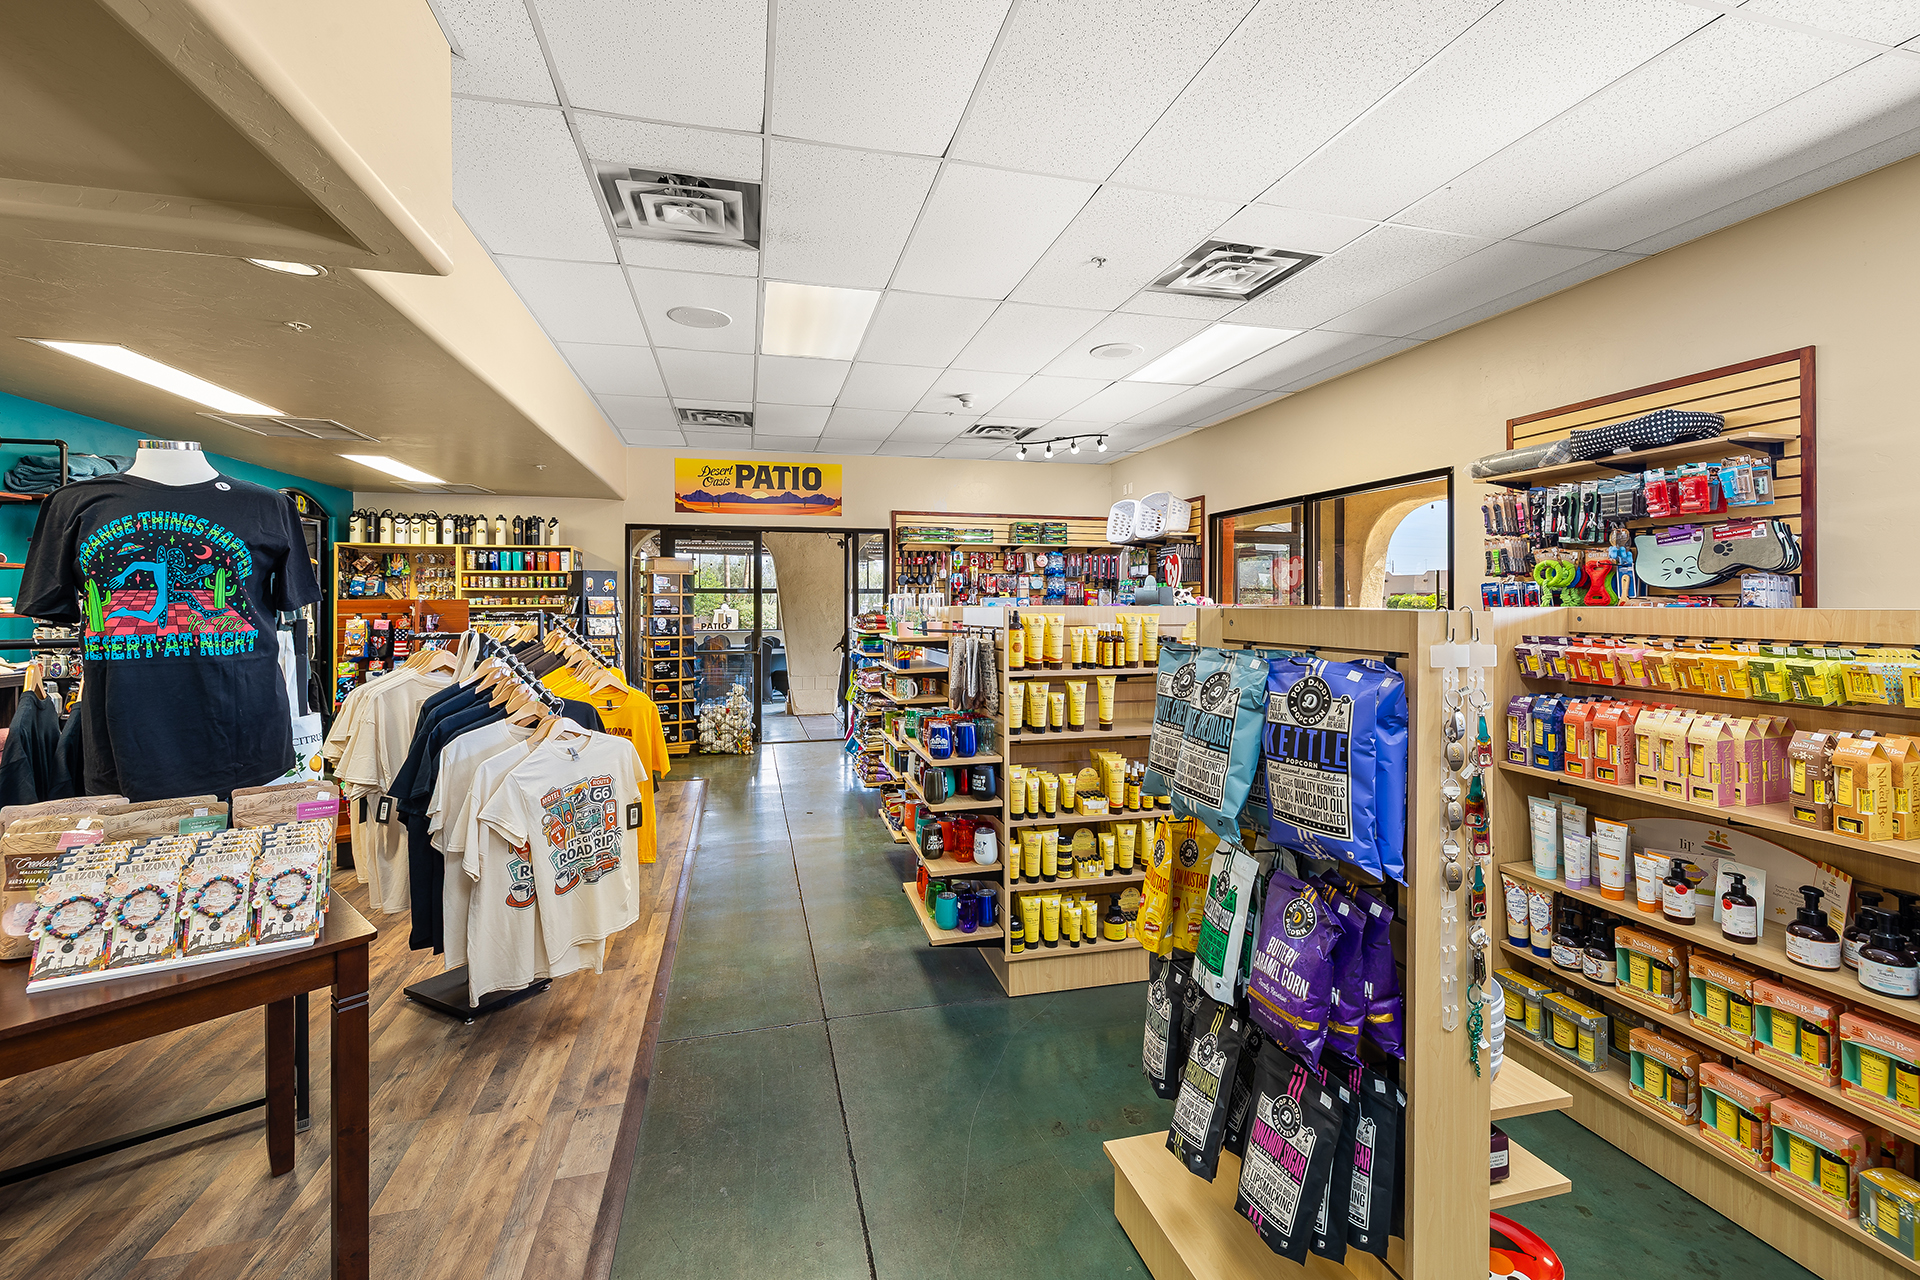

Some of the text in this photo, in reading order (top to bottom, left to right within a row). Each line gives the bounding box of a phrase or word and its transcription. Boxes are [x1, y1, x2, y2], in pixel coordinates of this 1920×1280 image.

[698, 464, 822, 490] Desert PATIO
[702, 476, 730, 487] Oasis
[137, 511, 209, 536] THINGS
[205, 523, 253, 580] HAPPEN
[1166, 557, 1178, 588] ty
[187, 614, 245, 632] In The
[701, 622, 729, 630] PATIO
[164, 632, 192, 658] AT
[200, 629, 259, 656] NIGHT
[1206, 675, 1220, 688] POP
[1291, 679, 1329, 700] POP DADDY
[1291, 706, 1325, 723] POPCORN
[1188, 736, 1208, 747] POPCORN
[1267, 722, 1348, 767] KETTLE
[1622, 728, 1631, 756] Naked
[1790, 741, 1809, 750] Naked
[1202, 757, 1226, 774] KERNELS
[1286, 758, 1318, 769] POPCORN
[1751, 742, 1760, 775] Naked
[1770, 740, 1779, 774] Naked
[1723, 743, 1733, 795] Naked Bee
[1210, 772, 1222, 788] OIL
[1294, 778, 1315, 792] QUALITY
[1317, 783, 1345, 798] KERNELS
[1910, 766, 1919, 804] Naked
[542, 791, 560, 804] MOTEL
[593, 787, 610, 800] 66
[1277, 785, 1345, 814] 100% AVOCADO OIL
[1876, 767, 1887, 828] Naked Bee
[1298, 805, 1346, 825] UNCOMPLICATED
[555, 832, 562, 841] 1
[568, 839, 580, 848] IT'S
[198, 852, 248, 865] ARIZONA
[269, 844, 315, 856] ARIZONA
[560, 844, 592, 865] ROAD
[56, 870, 110, 882] ARIZONA
[123, 860, 177, 874] ARIZONA
[1183, 870, 1209, 890] MUSTAR
[1300, 900, 1313, 924] DADDY
[1632, 939, 1663, 954] Naked Bee
[1281, 968, 1310, 1001] CORN
[1707, 969, 1740, 986] Naked Bee
[1776, 996, 1814, 1013] Naked Bee
[1867, 1031, 1915, 1053] Naked Bee
[1646, 1043, 1678, 1062] Naked Bee
[1717, 1079, 1749, 1101] Naked Bee
[1276, 1099, 1300, 1125] POP DADDY
[1273, 1114, 1295, 1136] PRETZELS
[1793, 1118, 1835, 1143] Naked Bee
[1254, 1142, 1292, 1177] PRETZEL STICKS
[1281, 1144, 1306, 1181] SUGAR
[1355, 1140, 1371, 1172] GAR
[1250, 1171, 1292, 1214] LIPSMACKING
[1276, 1179, 1283, 1191] SO
[1283, 1184, 1295, 1202] BOLD
[1352, 1181, 1366, 1194] BOLD
